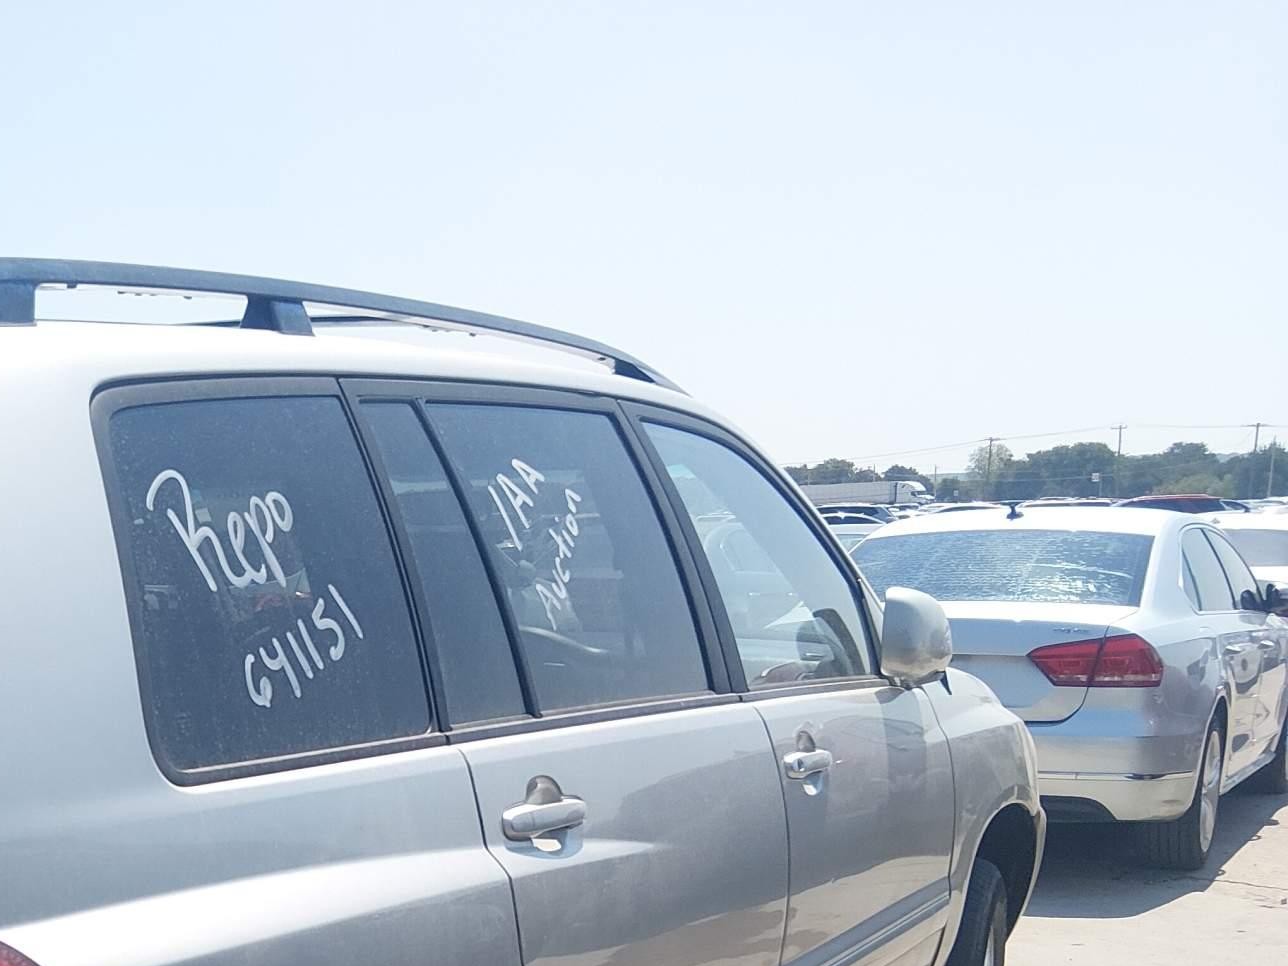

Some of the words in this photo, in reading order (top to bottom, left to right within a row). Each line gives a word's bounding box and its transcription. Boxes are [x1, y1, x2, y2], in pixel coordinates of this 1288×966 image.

[145, 468, 293, 592] Repo
[488, 458, 545, 551] IAA
[535, 488, 582, 631] Auction
[244, 584, 363, 708] 641151
